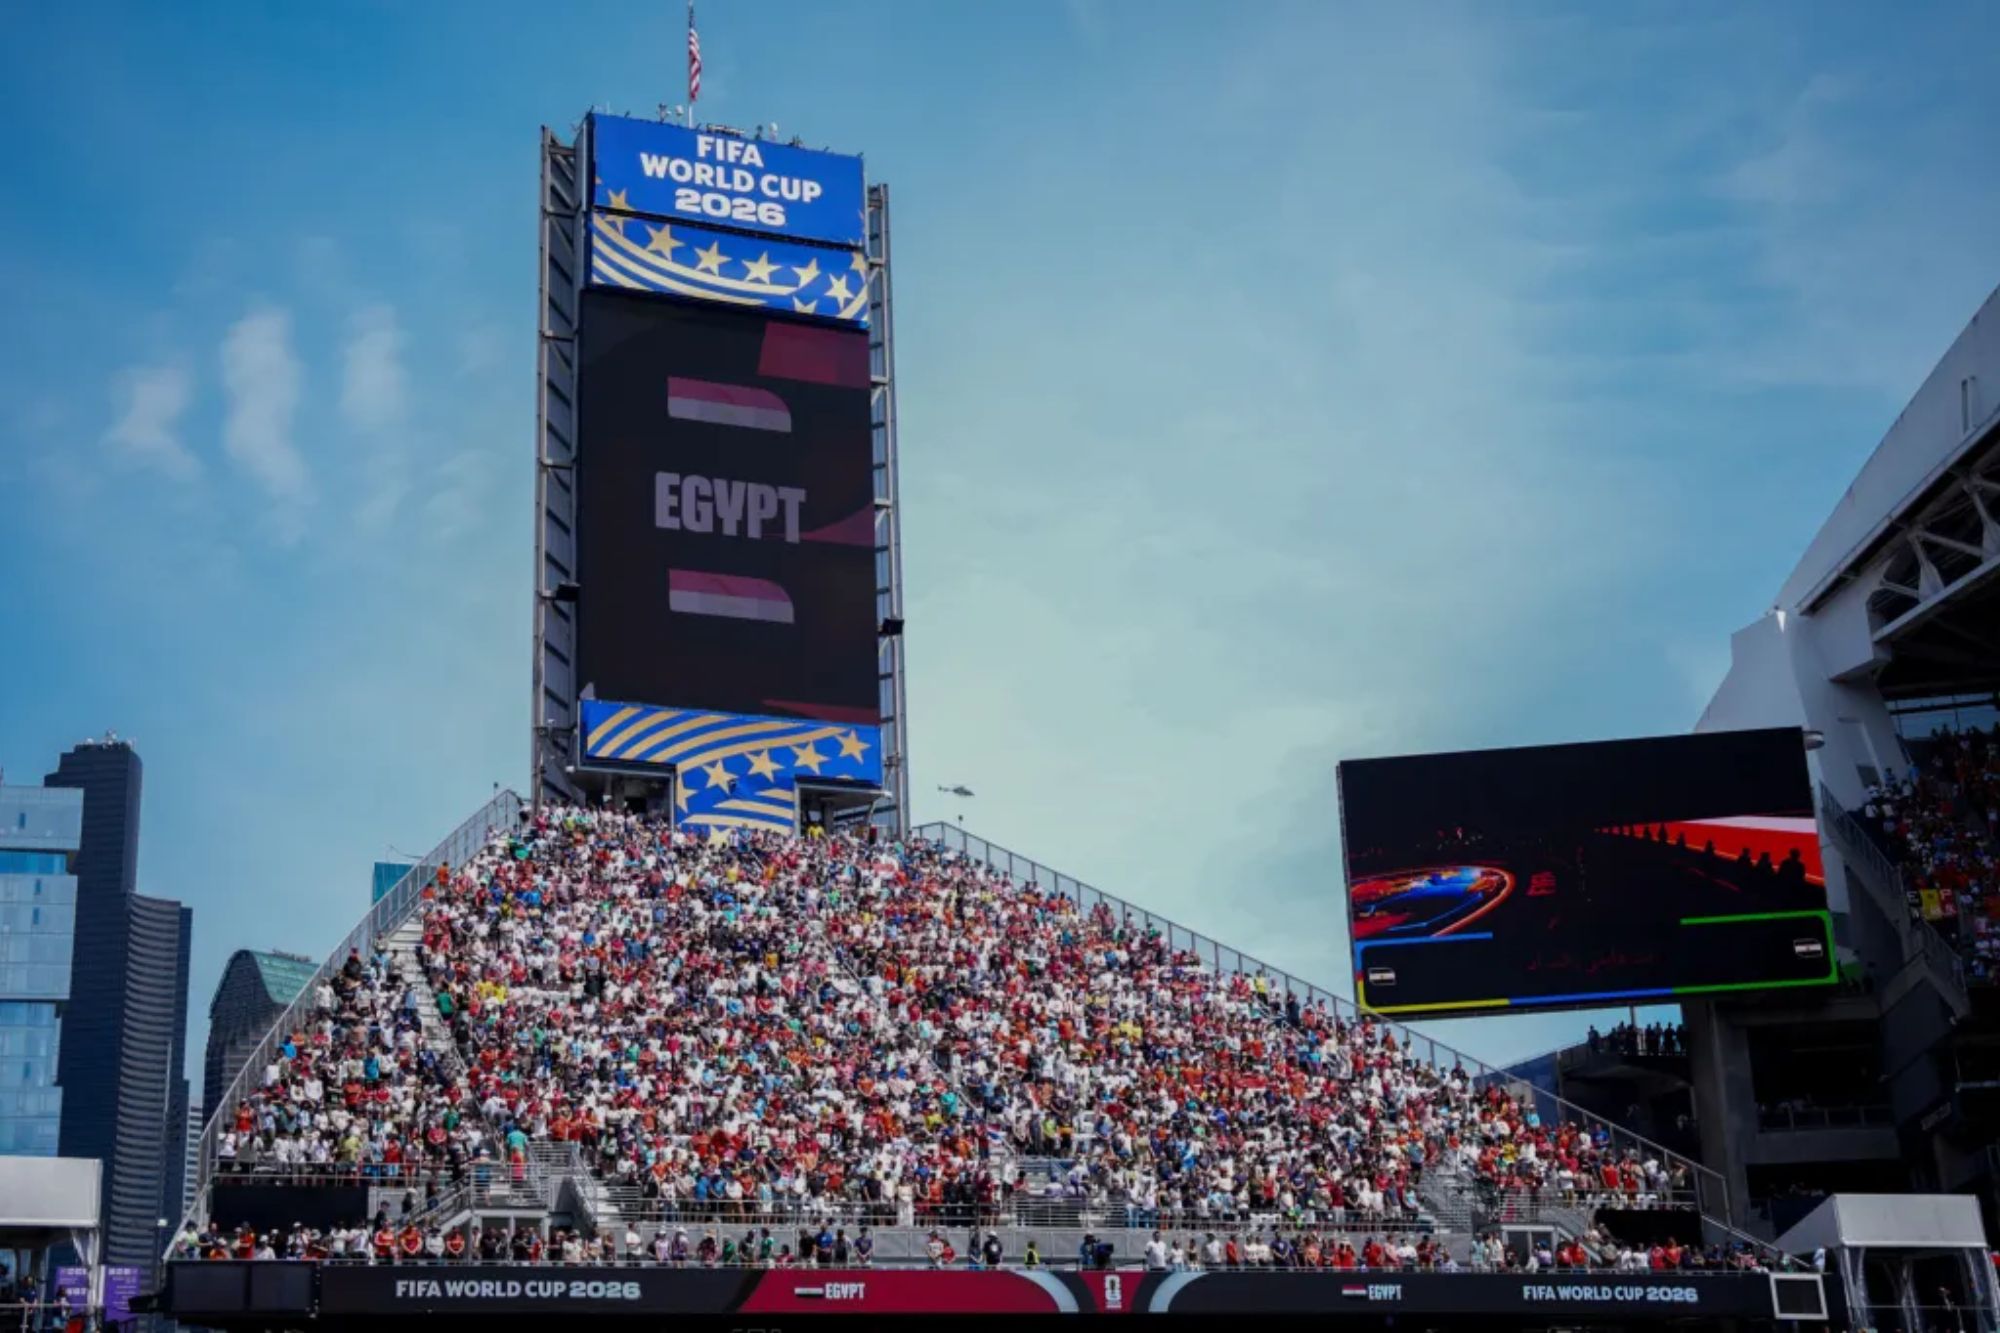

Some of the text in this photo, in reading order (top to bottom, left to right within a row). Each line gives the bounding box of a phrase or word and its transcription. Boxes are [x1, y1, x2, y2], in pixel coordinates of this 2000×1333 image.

[697, 135, 764, 167] FIFA
[640, 152, 823, 203] WORLD CUP
[675, 188, 786, 226] 2026
[654, 471, 807, 544] EGYPT
[395, 1280, 641, 1300] FIFA WORLD CUP 2026
[825, 1282, 866, 1299] EGYPT
[1368, 1285, 1402, 1300] EGYPT
[1522, 1285, 1698, 1302] FIFA WORLD CUP 2026
